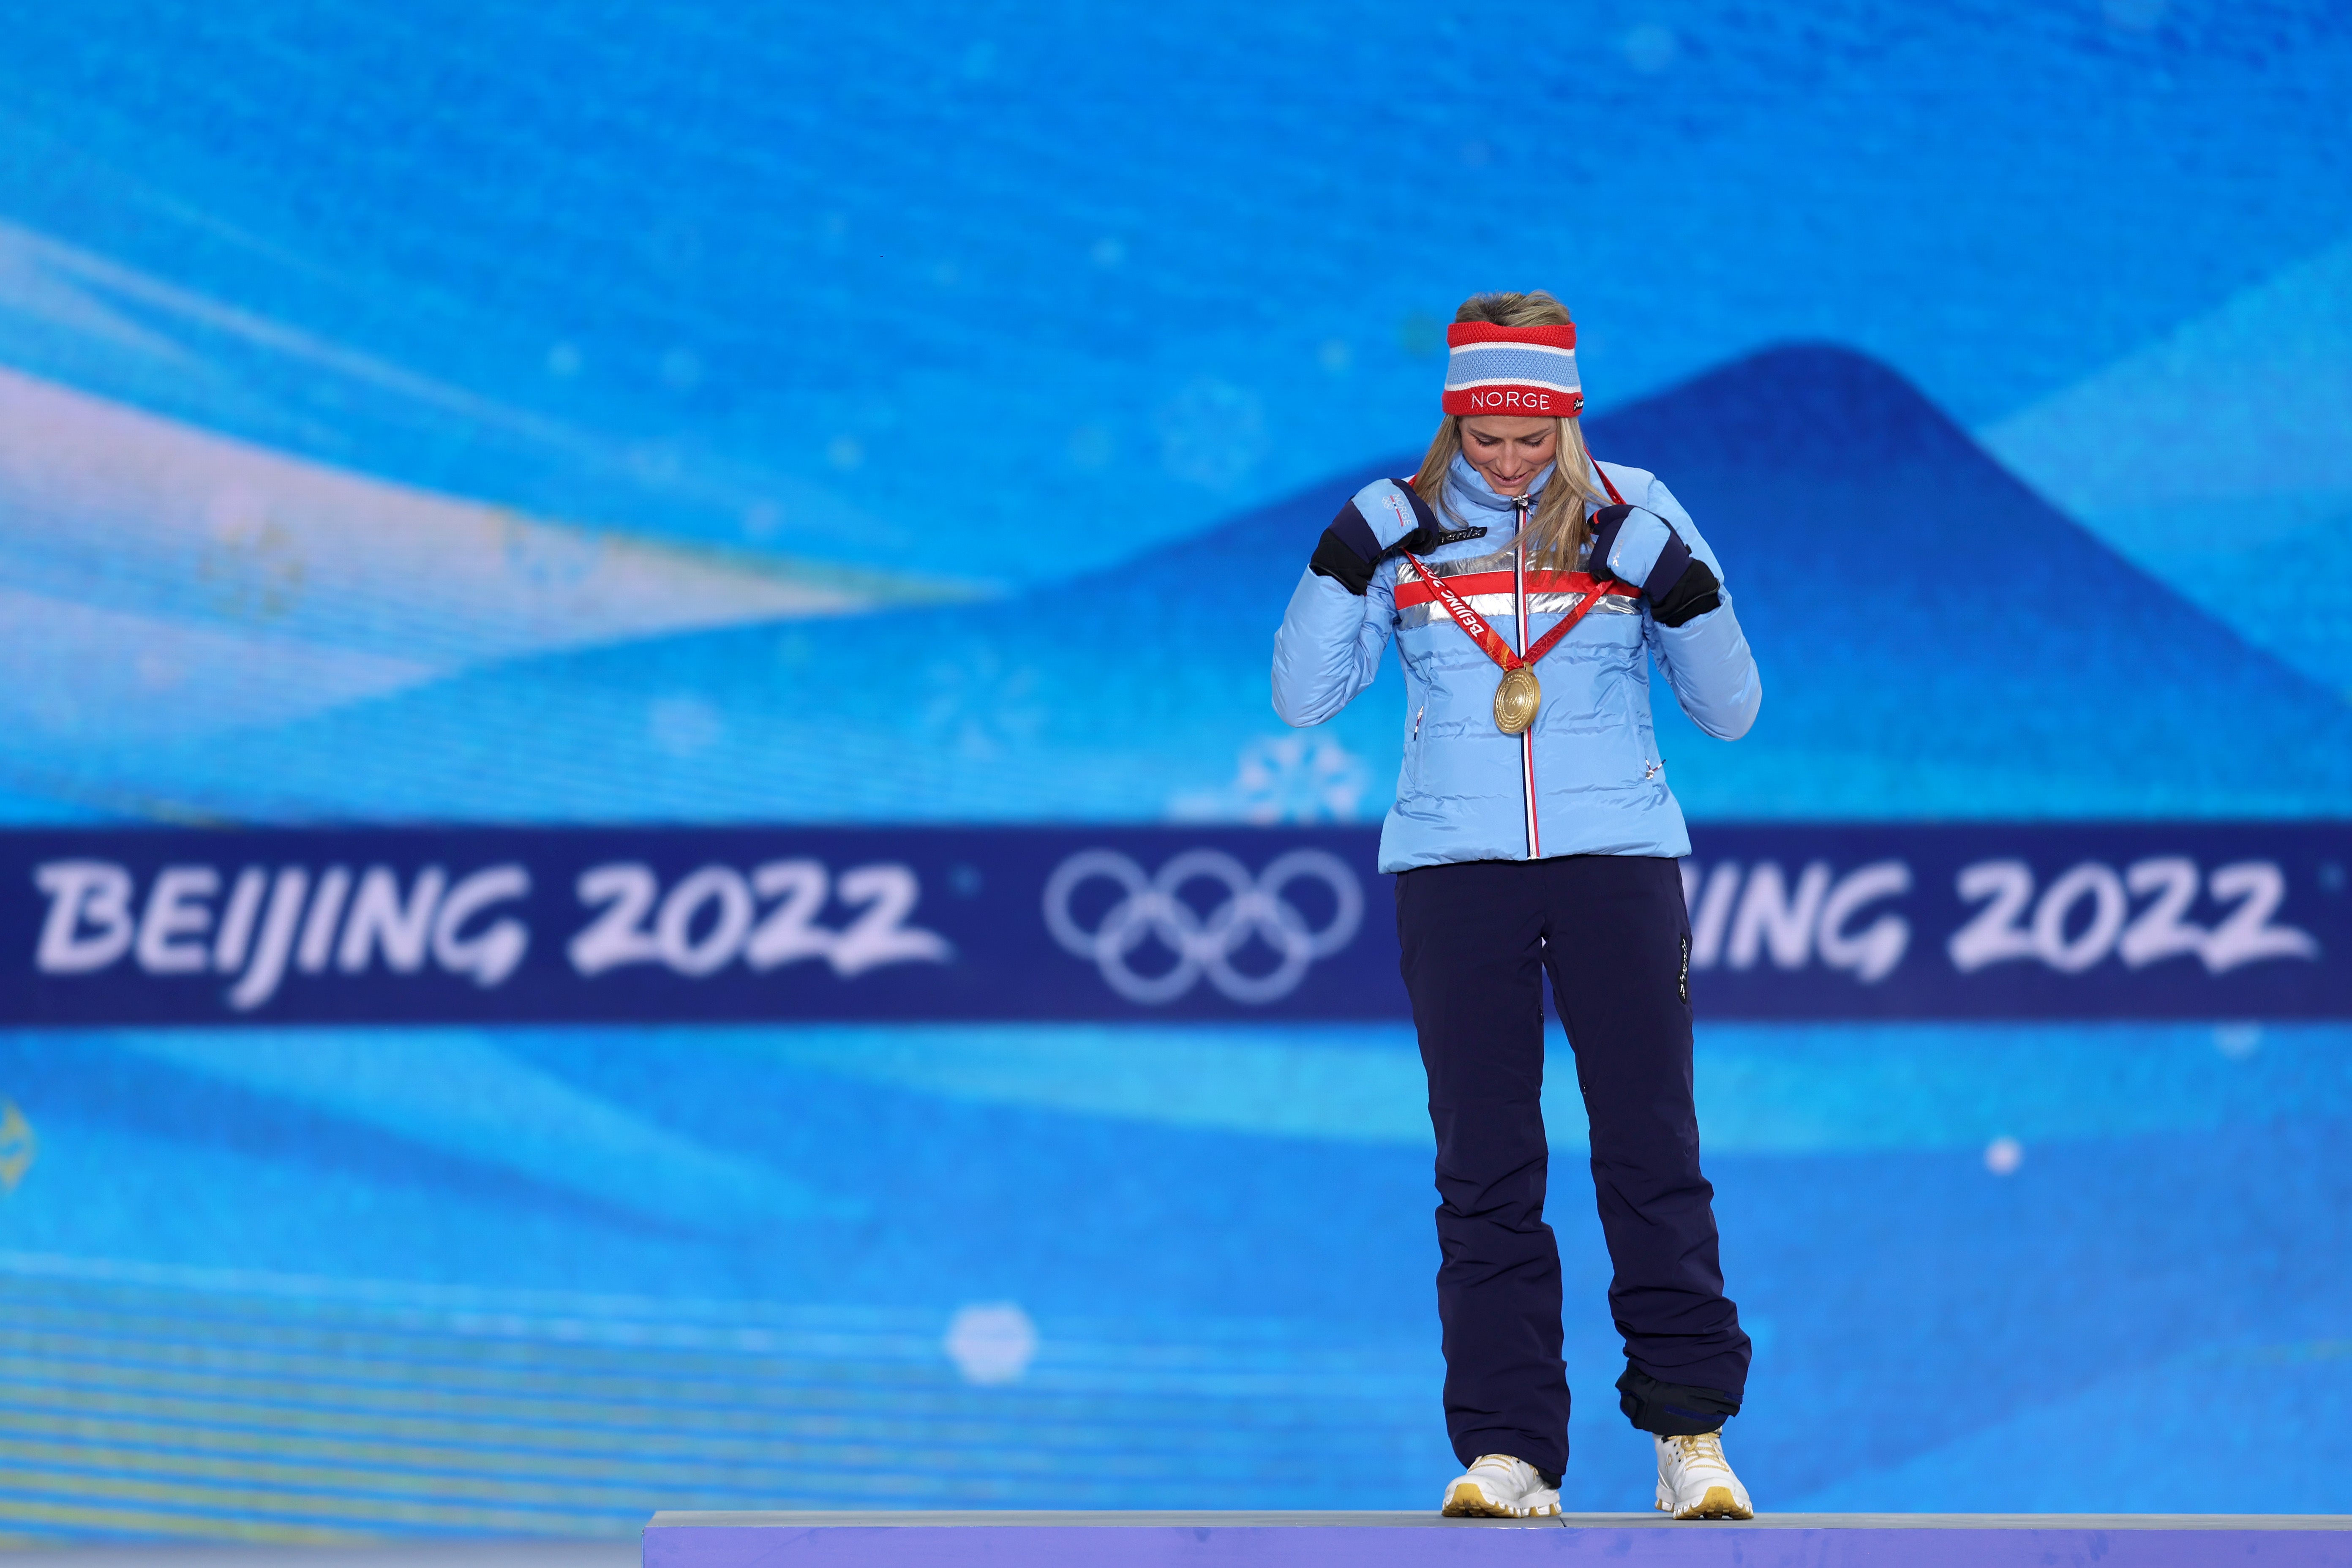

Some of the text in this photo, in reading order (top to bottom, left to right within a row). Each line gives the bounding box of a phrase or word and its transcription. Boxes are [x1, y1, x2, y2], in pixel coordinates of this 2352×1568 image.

[1472, 391, 1550, 410] NORGE
[1393, 494, 1412, 526] NORGE
[39, 862, 942, 1006] BEIJING 2022
[1951, 860, 2308, 970] 2022
